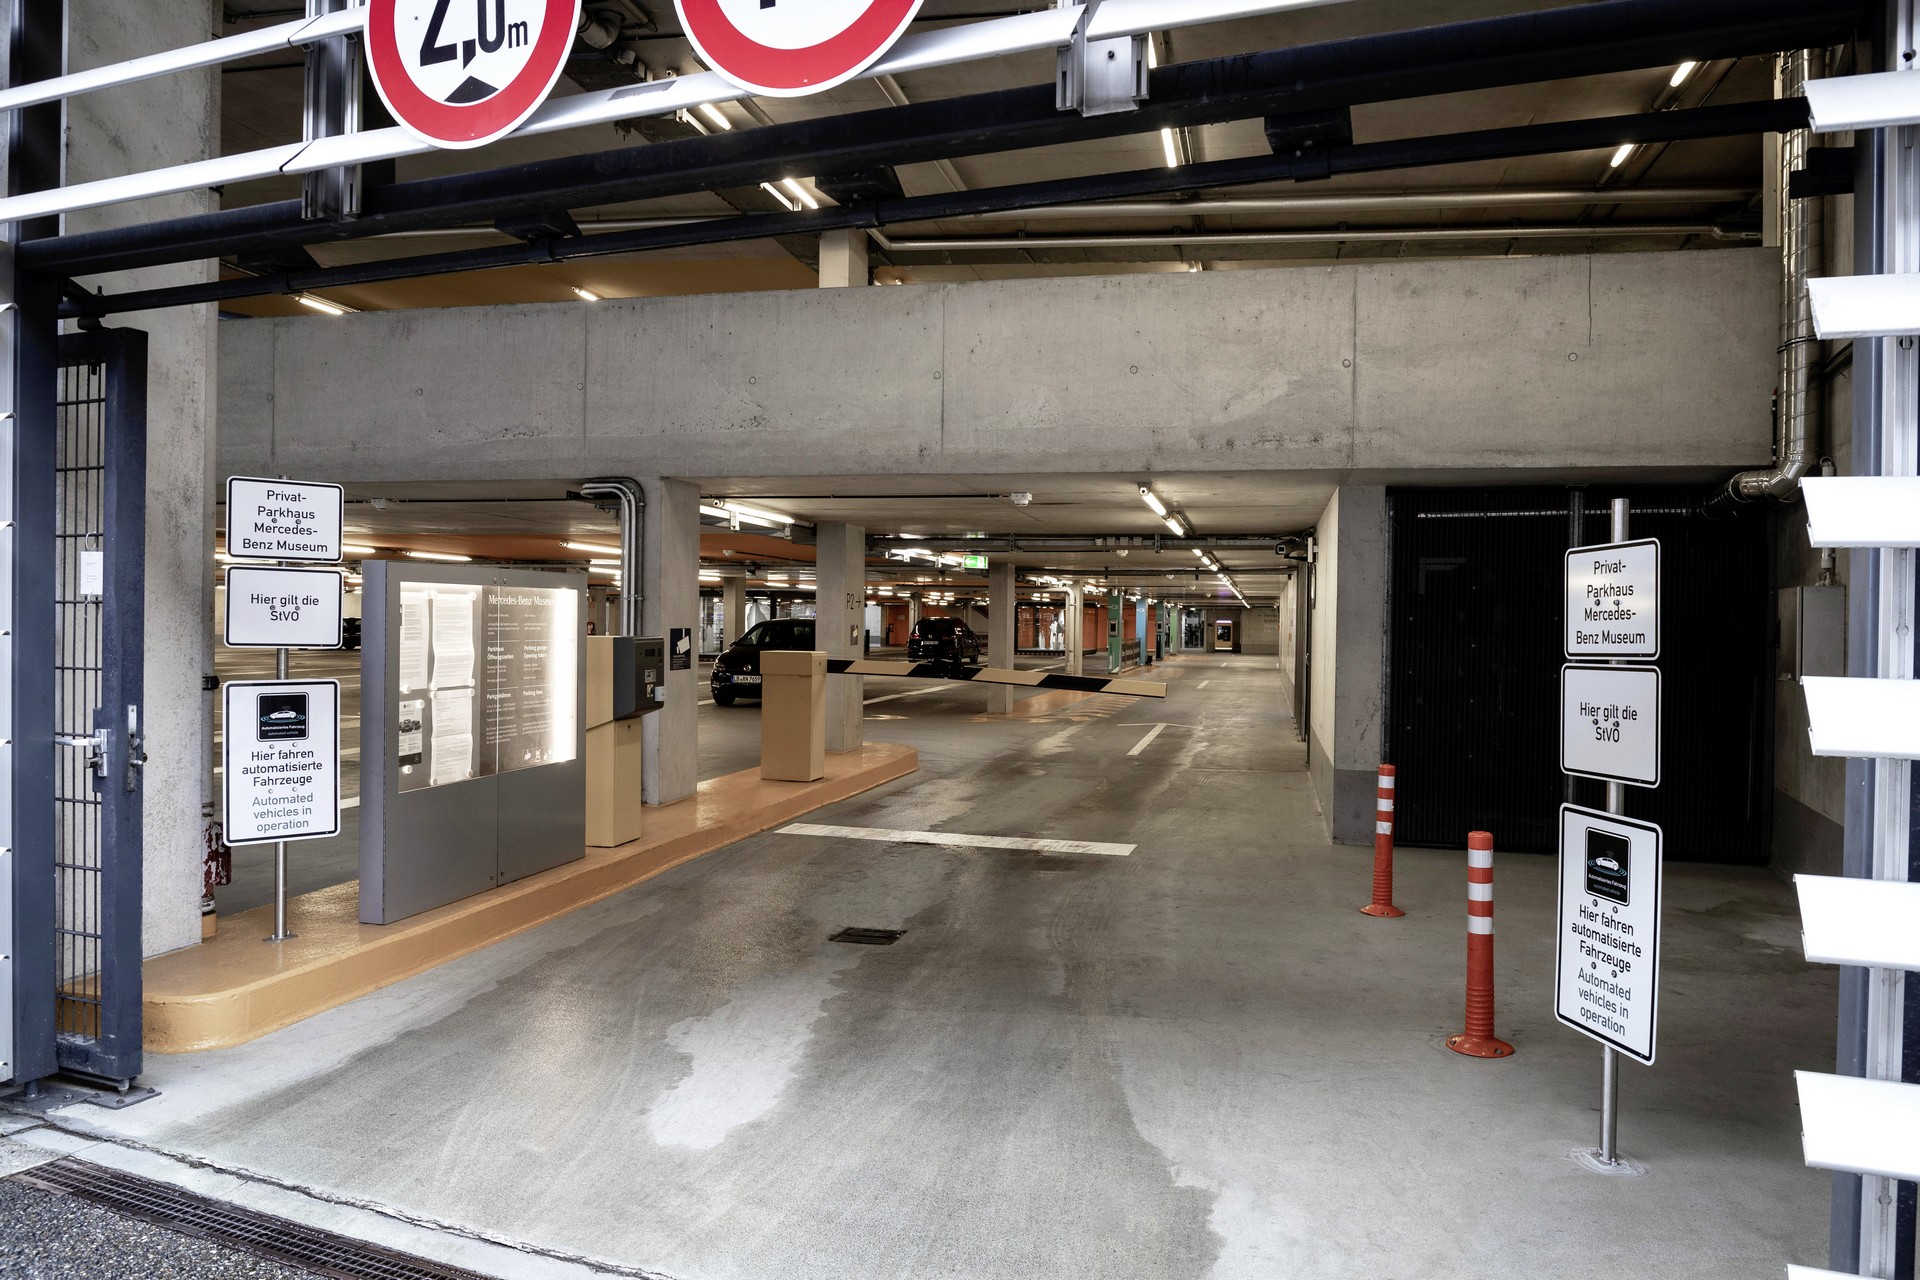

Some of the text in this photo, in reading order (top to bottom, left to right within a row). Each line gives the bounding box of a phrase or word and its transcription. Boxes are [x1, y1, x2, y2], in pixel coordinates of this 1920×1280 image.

[267, 490, 307, 502] Privat-
[257, 506, 315, 519] Parkhaus
[254, 522, 318, 536] Mercedes-
[243, 538, 328, 552] Benz Museum
[1594, 560, 1626, 575] Privat-
[1587, 583, 1634, 598] Parkhaus
[251, 593, 319, 607] Hier gilt die
[534, 596, 557, 605] Museu
[847, 593, 854, 609] P2
[270, 611, 299, 621] StVO
[1584, 606, 1636, 622] Mercedes-
[1576, 630, 1646, 644] Benz Museum
[1580, 702, 1638, 722] Hier gilt die
[1595, 727, 1620, 742] StVO
[252, 750, 314, 761] Hier fahren
[242, 761, 323, 774] automatisierte
[253, 775, 312, 786] Fahrzeuge
[252, 793, 314, 806] Automated
[254, 806, 312, 819] vehicles in
[257, 819, 309, 833] operation
[1579, 904, 1634, 936] Hier fahren
[1571, 922, 1642, 958] automatisierte
[1580, 940, 1631, 973] Fahrzeuge
[1578, 967, 1631, 1001] Automated
[1578, 987, 1629, 1019] vehicles in
[1580, 1006, 1625, 1037] operation
